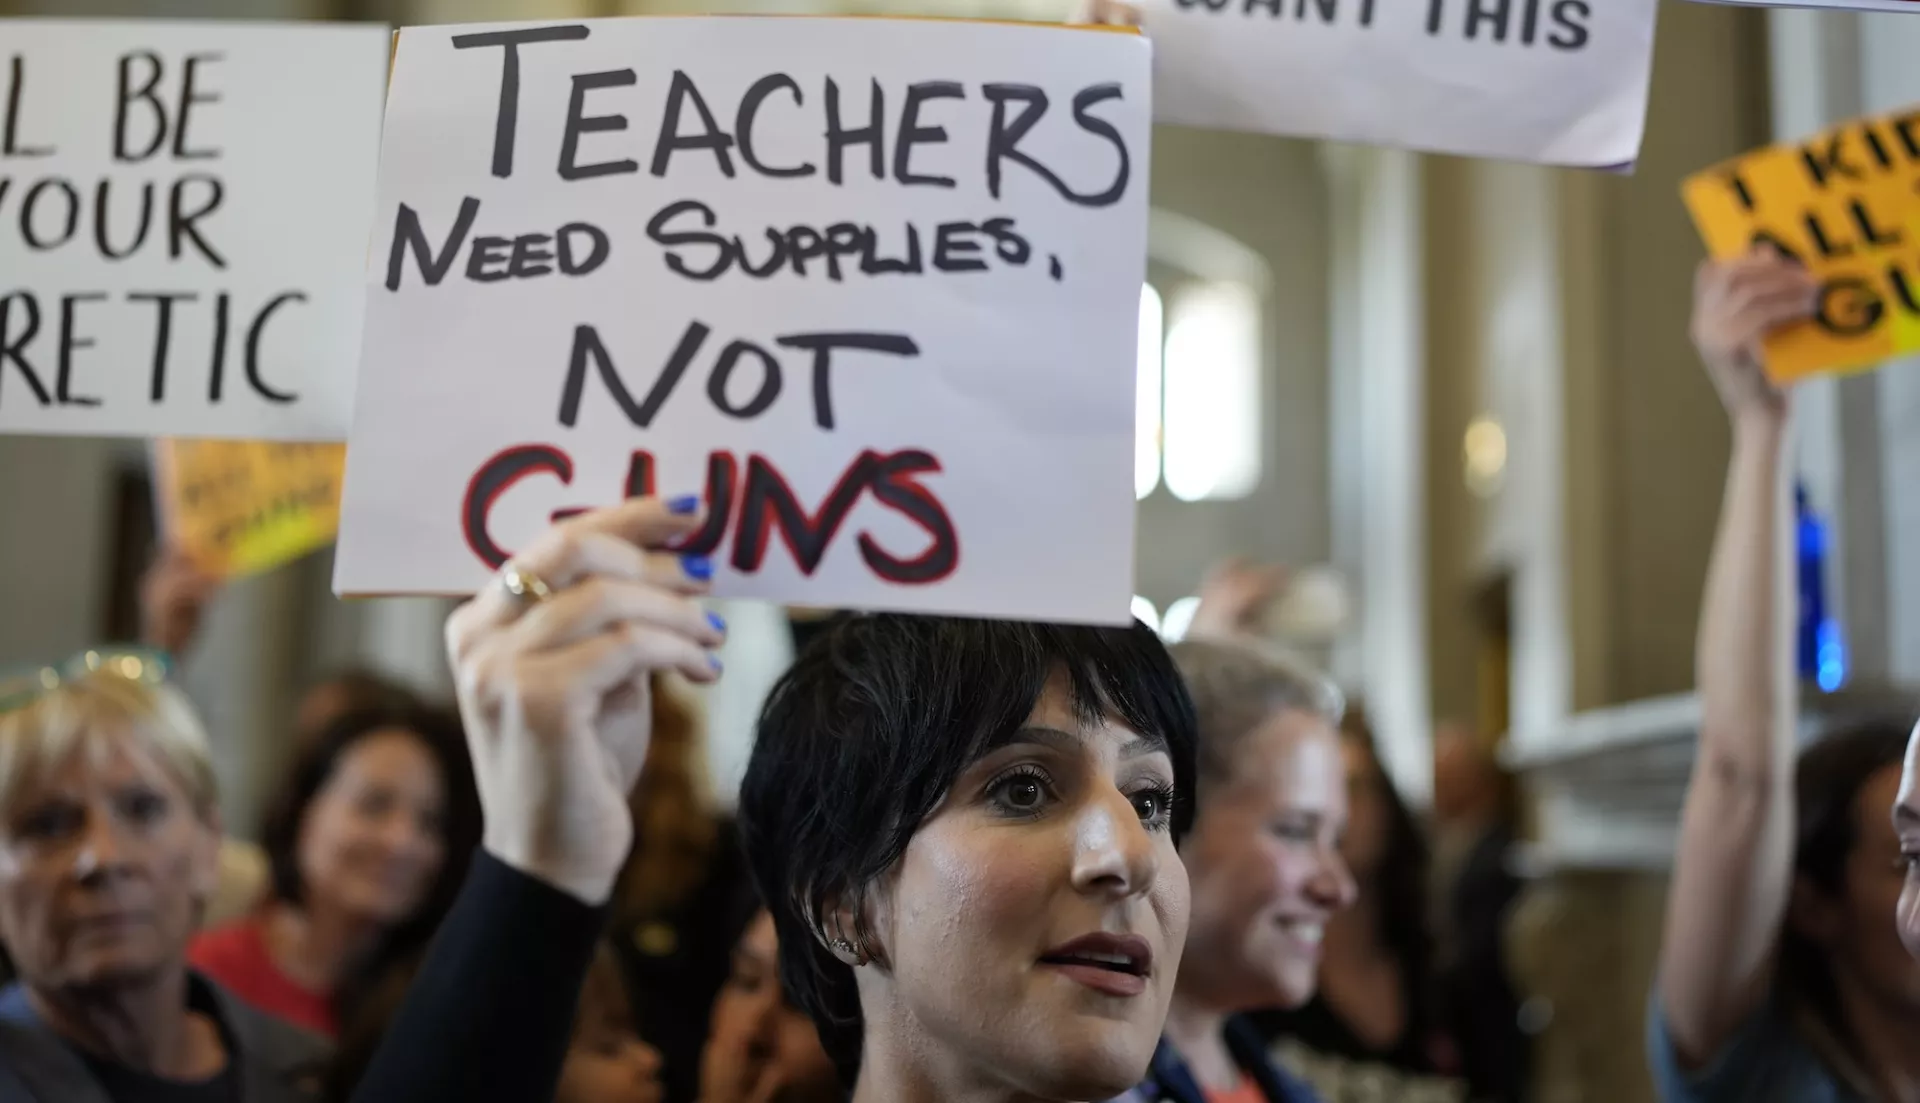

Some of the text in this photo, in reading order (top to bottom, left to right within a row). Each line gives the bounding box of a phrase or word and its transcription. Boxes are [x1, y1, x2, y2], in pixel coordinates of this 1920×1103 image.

[1425, 0, 1592, 51] THIS
[112, 50, 226, 162] BE
[451, 24, 1130, 208] TEACHERS
[0, 175, 228, 270] OUR
[384, 196, 1064, 292] NEED SUPPLIES,
[0, 289, 308, 407] RETIC
[557, 320, 922, 432] NOT
[461, 443, 961, 586] GUNS
